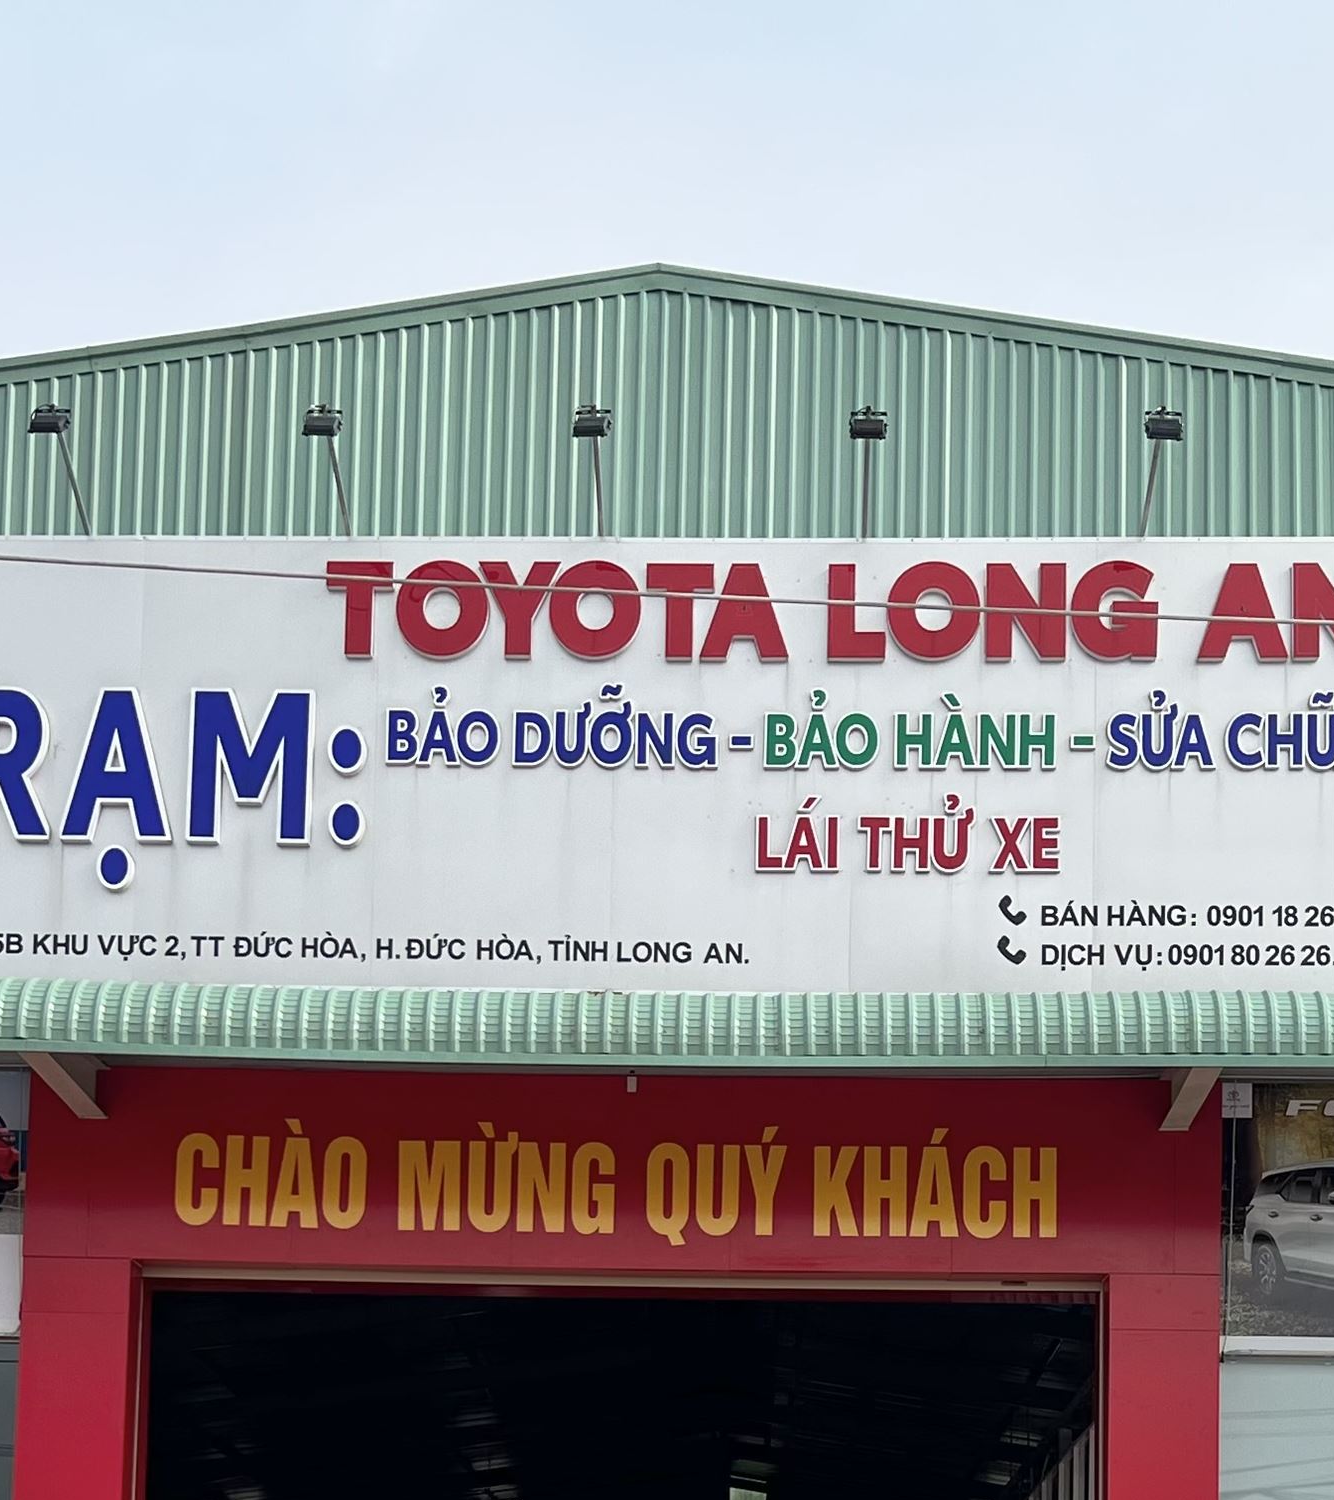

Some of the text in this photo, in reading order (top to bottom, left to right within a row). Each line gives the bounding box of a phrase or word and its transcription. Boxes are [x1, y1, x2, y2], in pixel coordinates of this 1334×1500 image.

[326, 560, 788, 662] TOYOTA
[827, 561, 1159, 663] LONG
[385, 686, 498, 768] BẢO
[511, 684, 718, 770] DƯỠNG
[763, 688, 879, 770] BẢO
[893, 690, 1057, 771] HÀNH
[1105, 688, 1213, 772] SỬA
[754, 792, 1062, 874] LÁI THỬ XE
[32, 933, 88, 956] KHU
[97, 934, 157, 961] VỰC
[233, 932, 293, 958] ĐỨC
[301, 931, 367, 962] HÒA,
[405, 934, 466, 961] ĐỨC
[476, 933, 542, 965] HÒA,
[548, 934, 608, 962] TỈNH
[616, 941, 693, 964] LONG
[703, 942, 750, 965] AN.
[1040, 900, 1099, 927] BÁN
[1107, 900, 1198, 928] HÀNG:
[1206, 905, 1265, 928] 0901
[1271, 905, 1299, 928] 18
[1304, 905, 1334, 928] 26
[1040, 944, 1105, 972] DỊCH
[1167, 944, 1224, 966] 0901
[1231, 944, 1261, 966] 80
[1265, 944, 1295, 966] 26
[174, 1118, 1059, 1246] CHÀO MỪNG QUÝ KHÁCH
